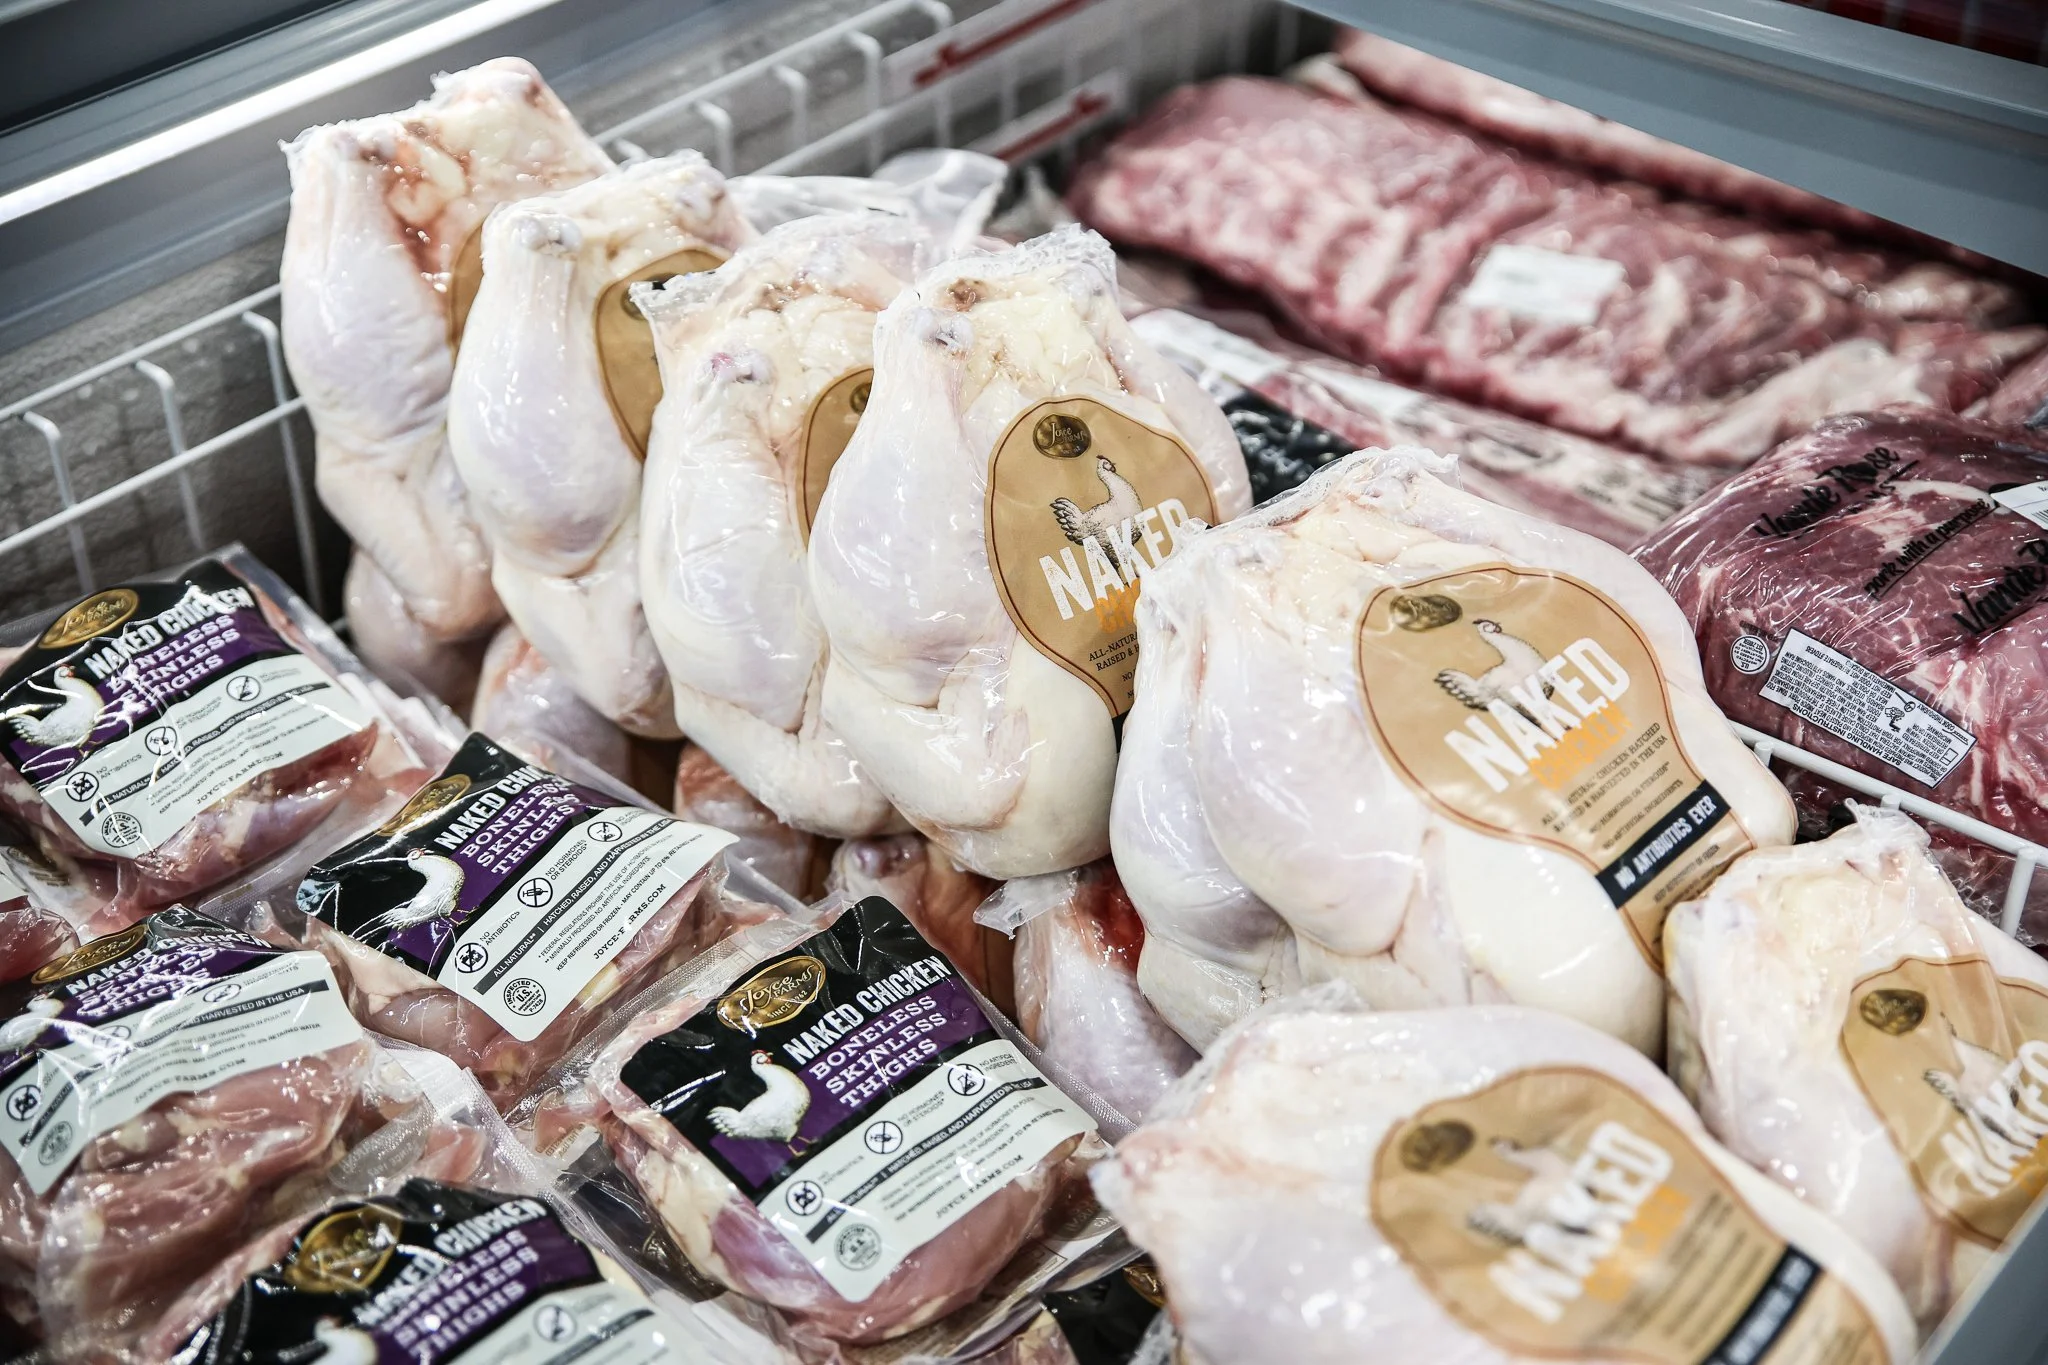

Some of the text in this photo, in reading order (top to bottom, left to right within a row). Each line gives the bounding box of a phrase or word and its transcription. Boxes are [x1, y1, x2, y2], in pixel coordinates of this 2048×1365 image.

[1039, 498, 1190, 621] NAKED
[1864, 499, 1990, 599] pork with a purpose
[85, 620, 162, 678] NAKED
[1089, 631, 1138, 661] ALL-NATURA
[1096, 652, 1126, 671] RAISED
[1444, 637, 1631, 793] NAKED
[1880, 689, 1892, 699] KEEP
[1792, 703, 1901, 766] SAFE HANDLING INSTRUCTIONS
[1865, 713, 1877, 723] KEEP
[1868, 731, 1879, 739] THAT
[1941, 720, 1955, 731] COOK
[1638, 746, 1655, 761] THE
[1652, 735, 1667, 749] USA
[1879, 736, 1899, 751] BACTERIA
[1884, 746, 1905, 761] PREPARED
[1928, 751, 1939, 759] KEEP
[435, 787, 505, 849] NAKED
[492, 804, 574, 874] THIGHS
[1615, 867, 1635, 888] NO
[1634, 818, 1691, 873] ANTIBIOTICS
[1688, 795, 1716, 824] EVER
[545, 866, 556, 877] NO
[550, 870, 561, 880] OR
[479, 931, 490, 942] NO
[485, 911, 520, 946] ANTIBIOTICS
[493, 965, 507, 977] ALL
[543, 898, 574, 926] HATCHED,
[570, 876, 596, 899] RAISED,
[593, 860, 608, 876] AND
[540, 937, 561, 956] FEDERAL
[558, 910, 587, 938] REGULATIONS
[585, 891, 605, 912] PROHIBIT
[603, 882, 614, 892] THE
[549, 884, 624, 959] MINIMALLY NO ARTIFICIAL
[556, 957, 568, 971] KEEP
[567, 929, 598, 959] REFRIGERATED
[596, 923, 605, 931] OR
[621, 892, 632, 903] MAY
[630, 874, 650, 893] CONTAIN
[648, 867, 656, 875] UP
[654, 861, 662, 869] TO
[594, 884, 666, 959] JOYCE-FRMS.COM
[66, 948, 153, 994] NAKED
[507, 980, 531, 1005] INSPECTED
[773, 965, 815, 997] FARMS
[201, 987, 305, 1021] HARVESTED IN THE USA
[515, 986, 532, 1002] U.S.
[740, 975, 794, 1018] Joyce
[784, 957, 949, 1064] NAKED CHICKEN
[810, 996, 936, 1079] BONELESS
[826, 1013, 946, 1093] SKINLESS
[840, 1039, 936, 1106] THIGHS
[963, 1089, 1005, 1123] HARVESTED
[436, 1193, 545, 1262] CHICKEN
[1489, 1121, 1674, 1324] NAKED
